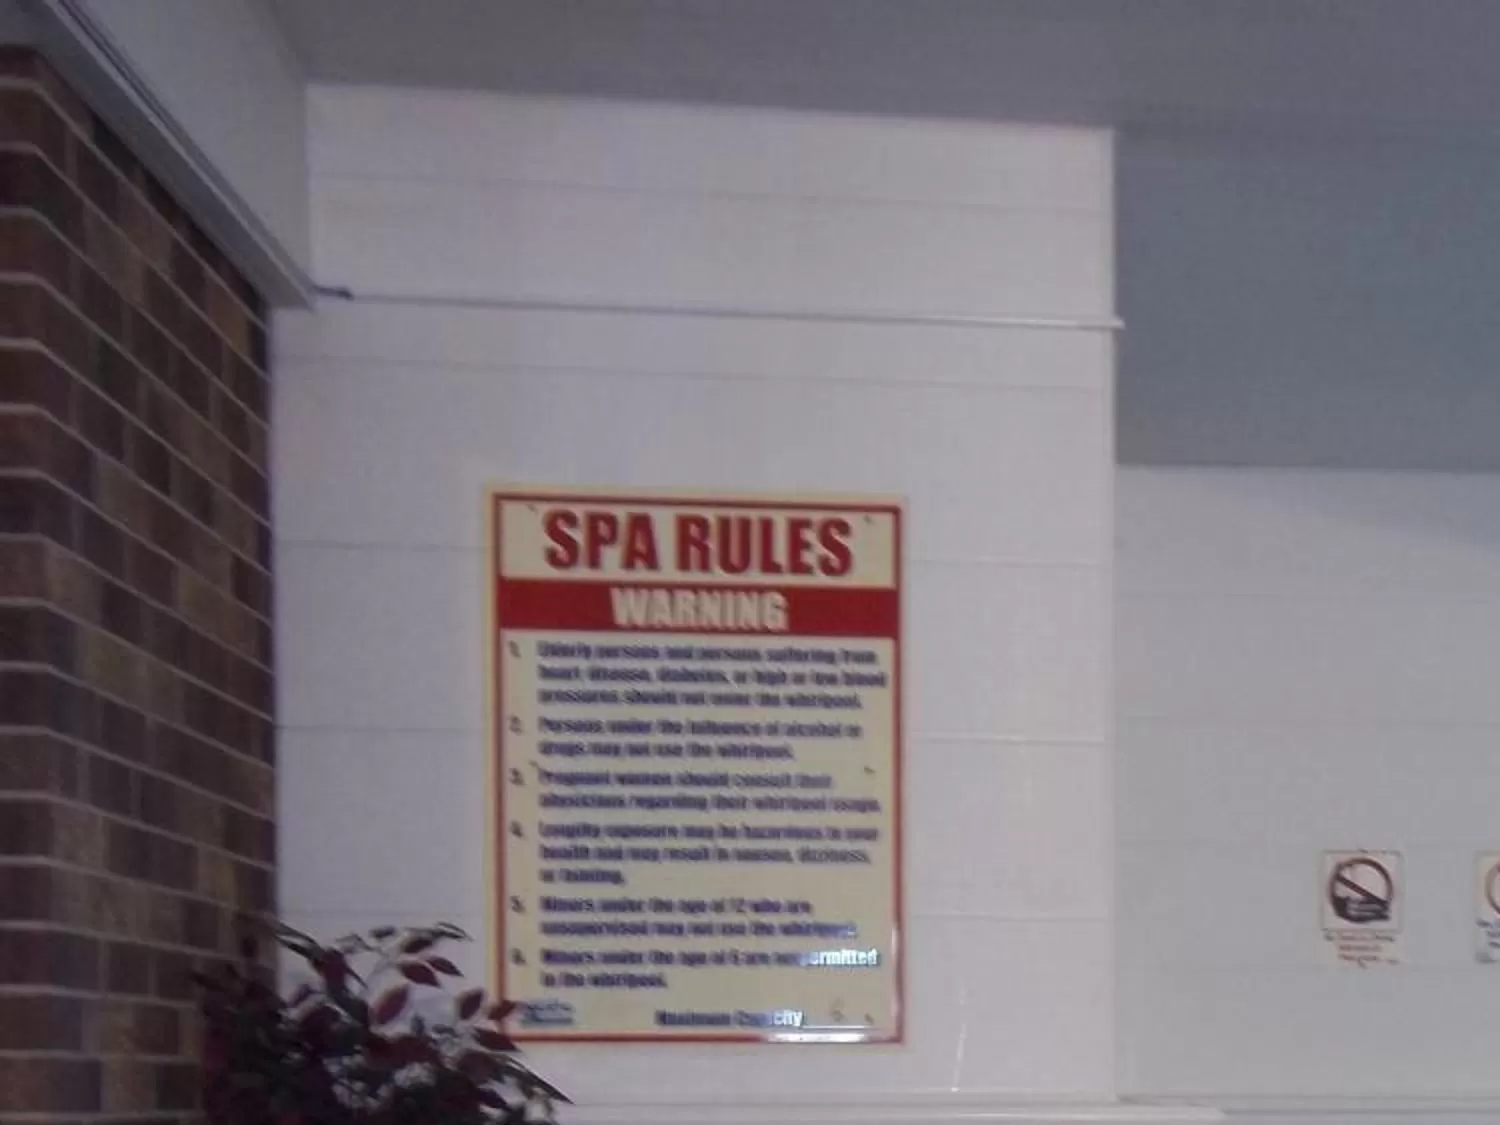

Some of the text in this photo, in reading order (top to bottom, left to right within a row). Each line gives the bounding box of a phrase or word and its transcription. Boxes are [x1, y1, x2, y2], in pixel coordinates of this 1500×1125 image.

[543, 509, 853, 577] SPA RULES
[610, 586, 791, 632] WARNING
[667, 644, 694, 660] and
